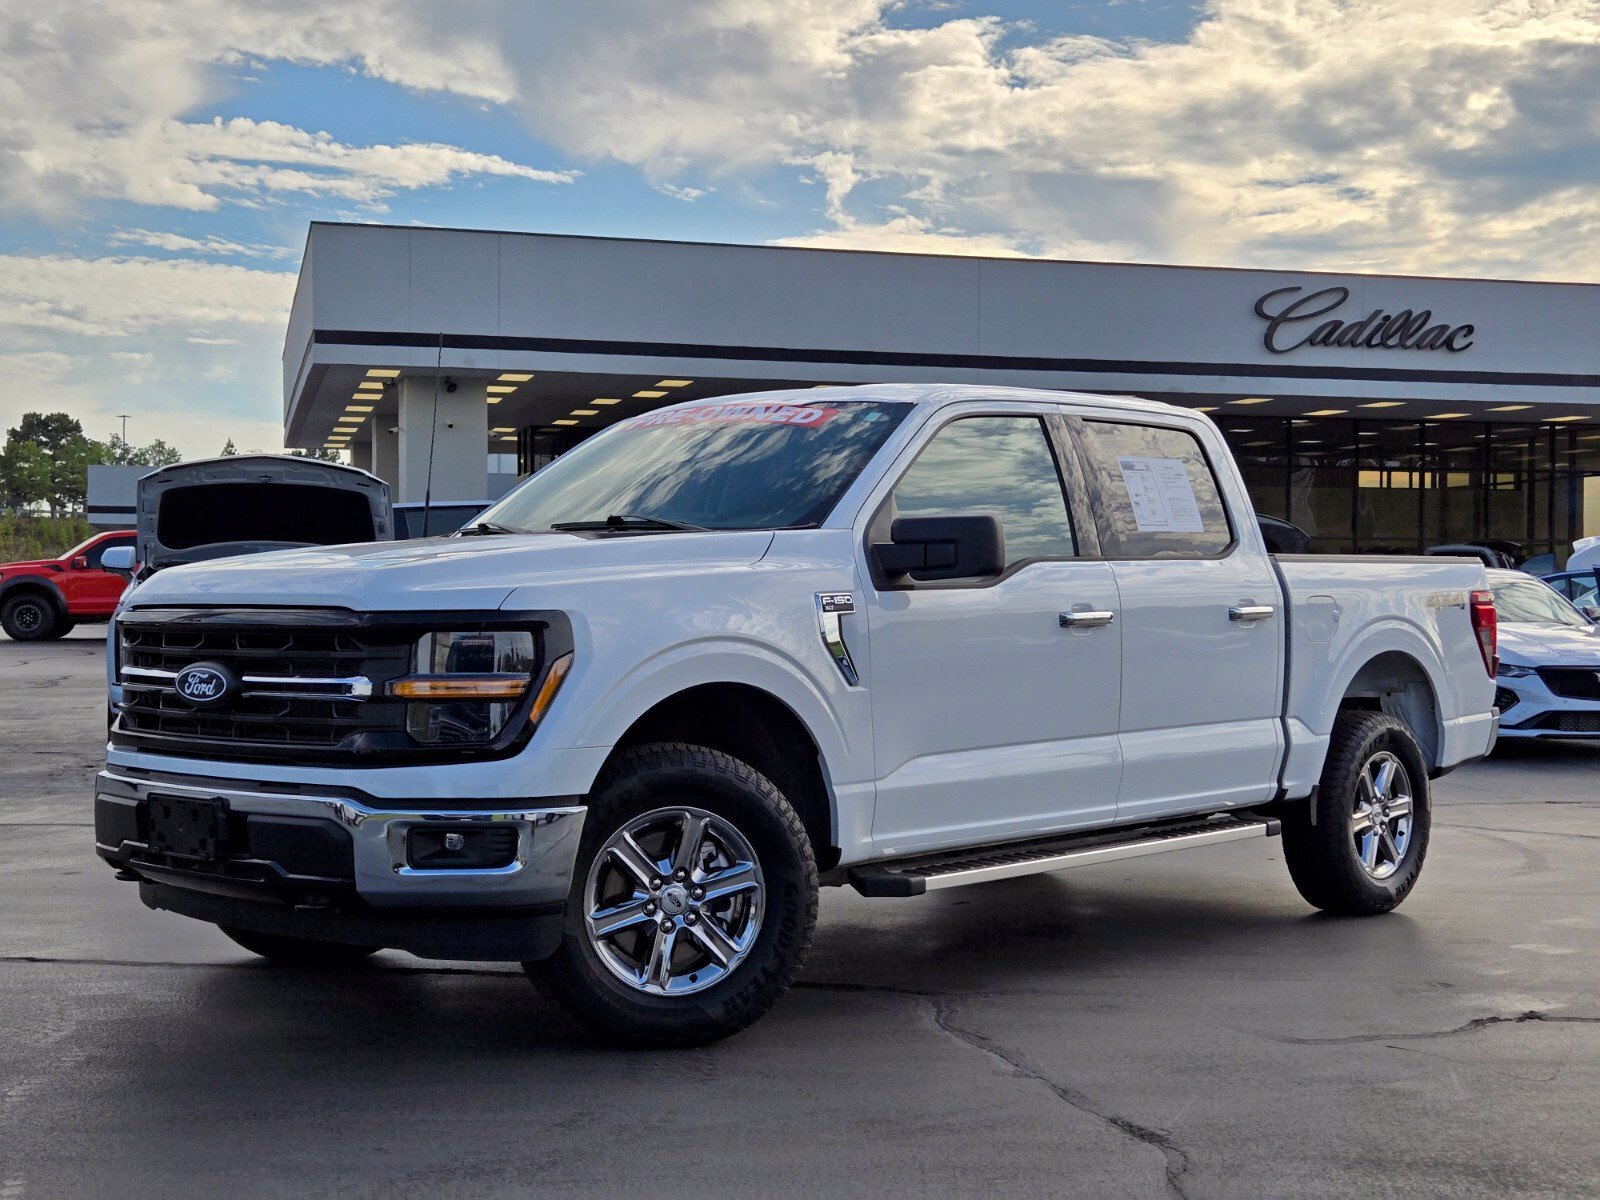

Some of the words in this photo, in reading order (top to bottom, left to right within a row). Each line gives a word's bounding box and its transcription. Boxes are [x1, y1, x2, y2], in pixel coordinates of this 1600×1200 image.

[1254, 286, 1475, 354] Cadillac
[822, 596, 853, 605] F-150
[184, 672, 217, 696] Ford
